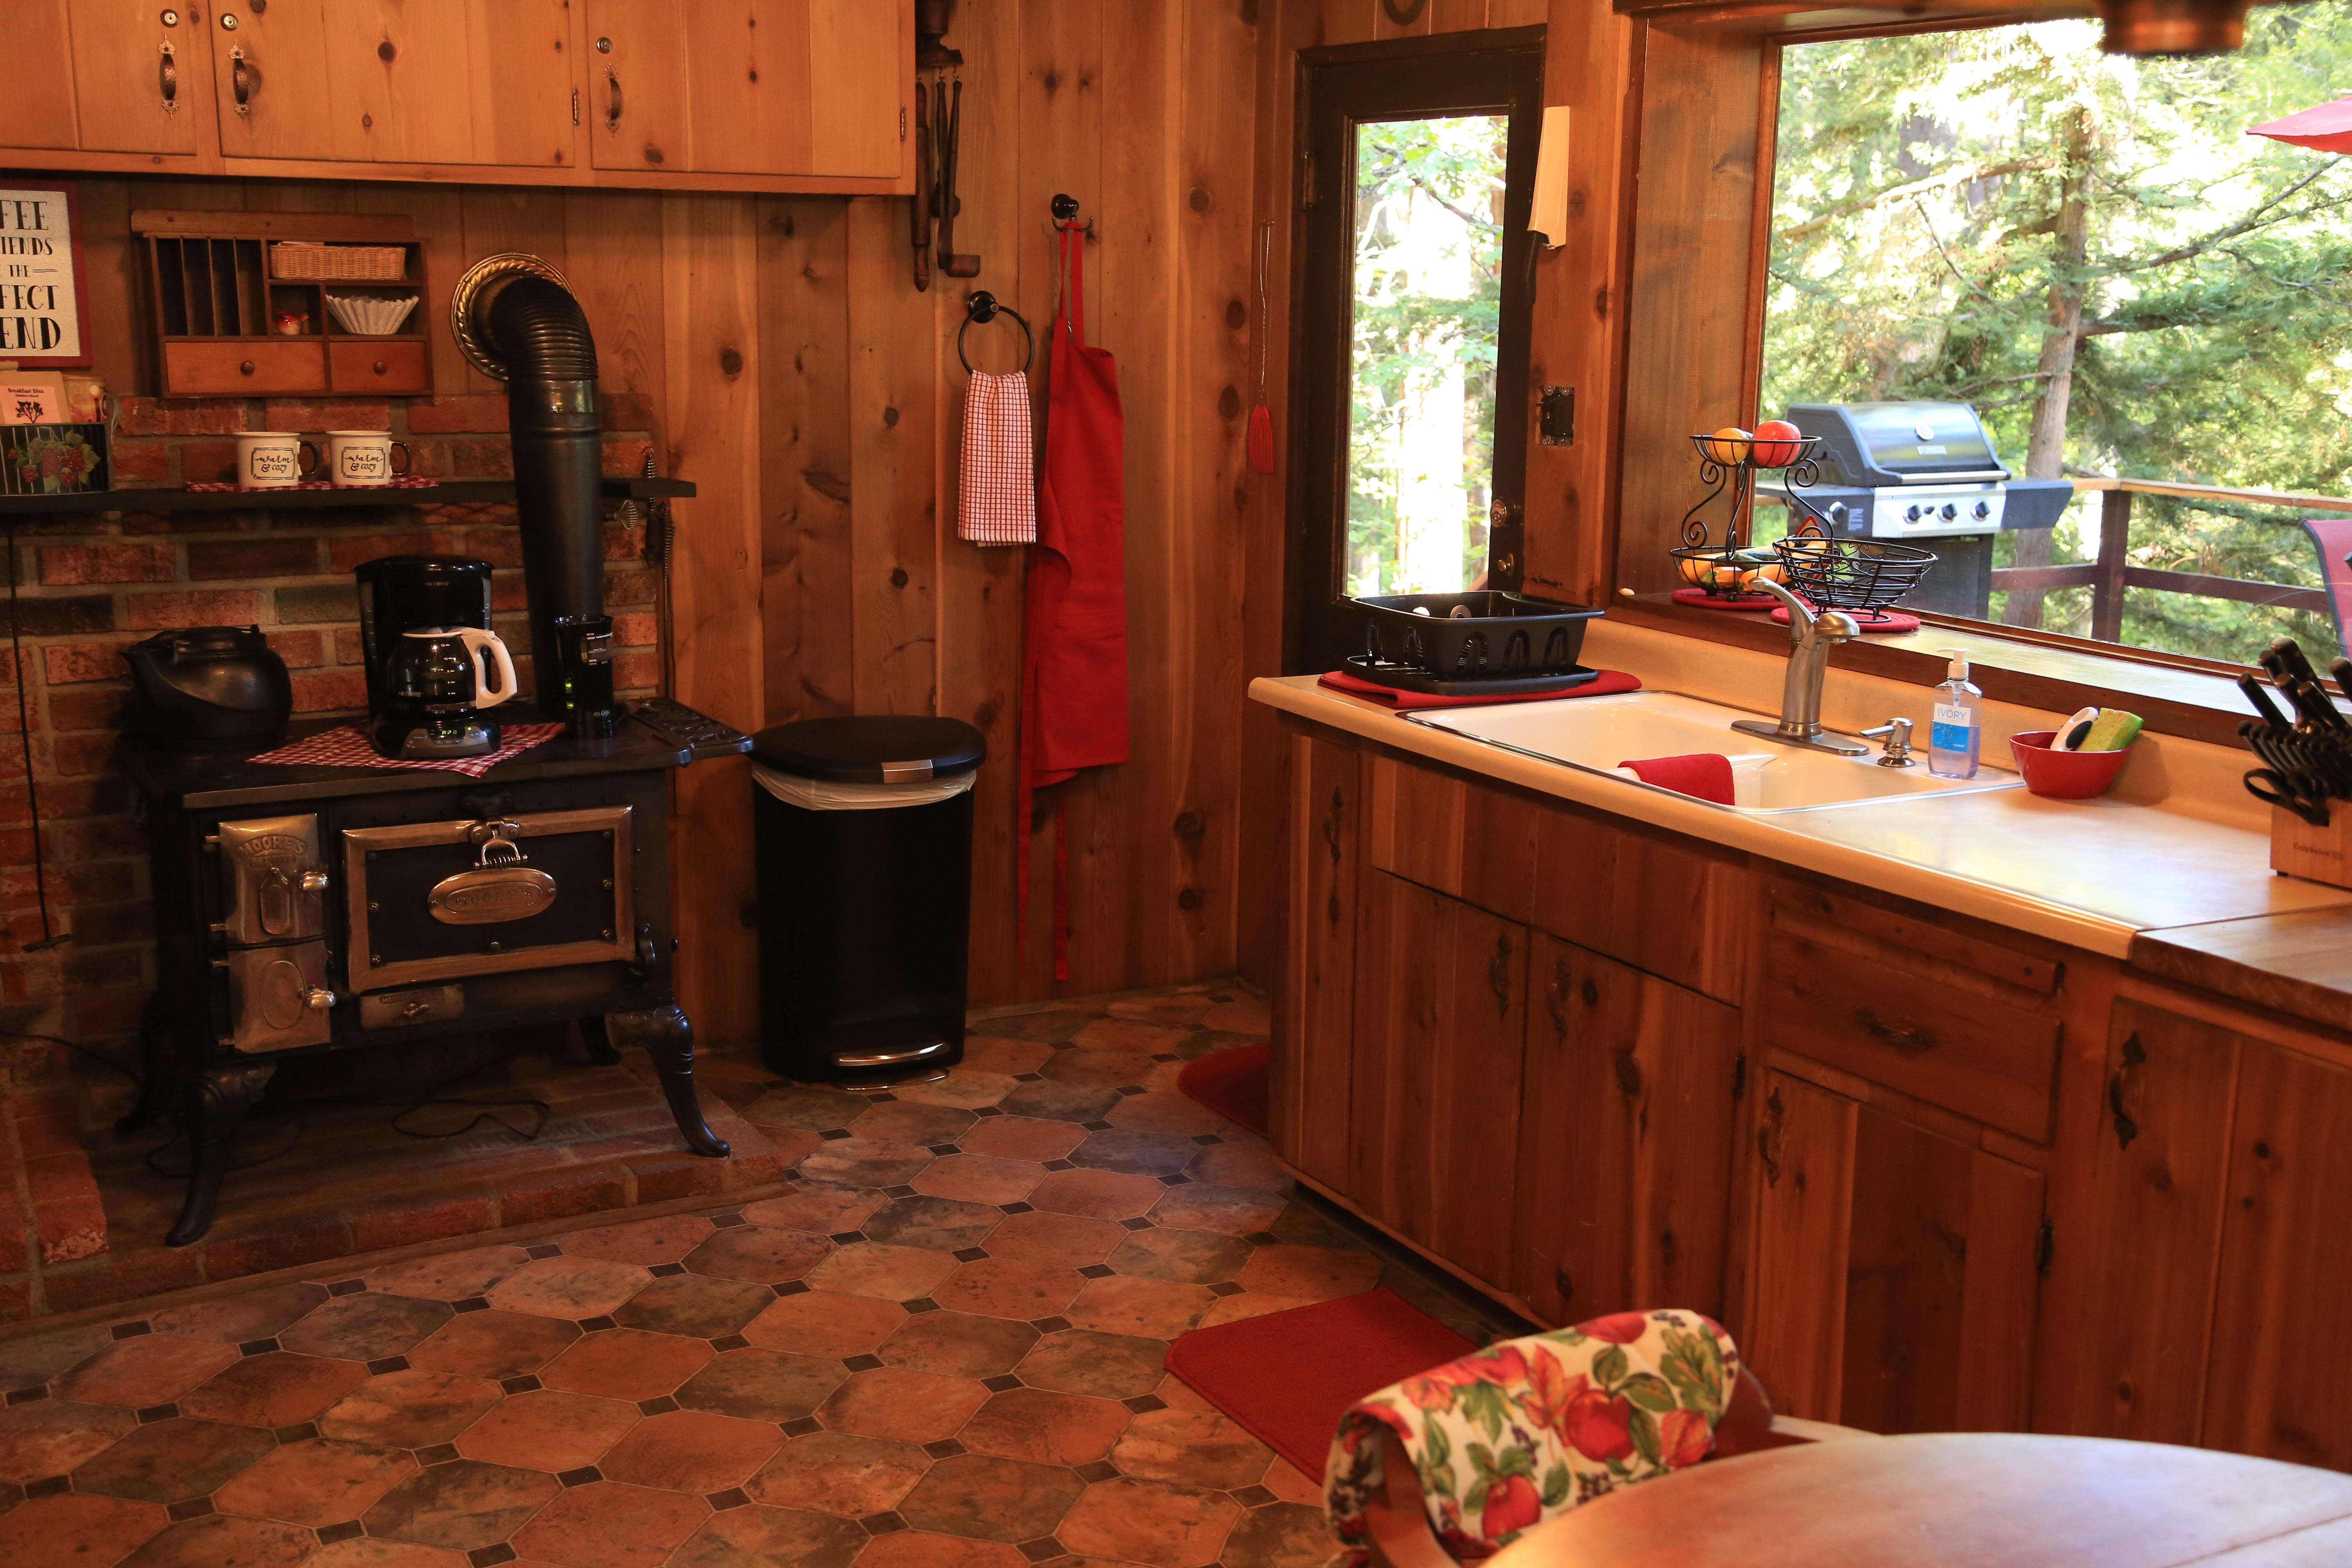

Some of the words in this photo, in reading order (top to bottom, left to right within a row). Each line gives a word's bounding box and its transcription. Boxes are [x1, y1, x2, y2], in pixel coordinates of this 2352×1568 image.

[7, 265, 30, 277] THE
[261, 464, 270, 472] &
[272, 464, 287, 473] cozy
[351, 463, 359, 471] &
[361, 463, 376, 472] cozy
[1938, 708, 1966, 719] IVORY
[455, 887, 531, 906] MOORE'S
